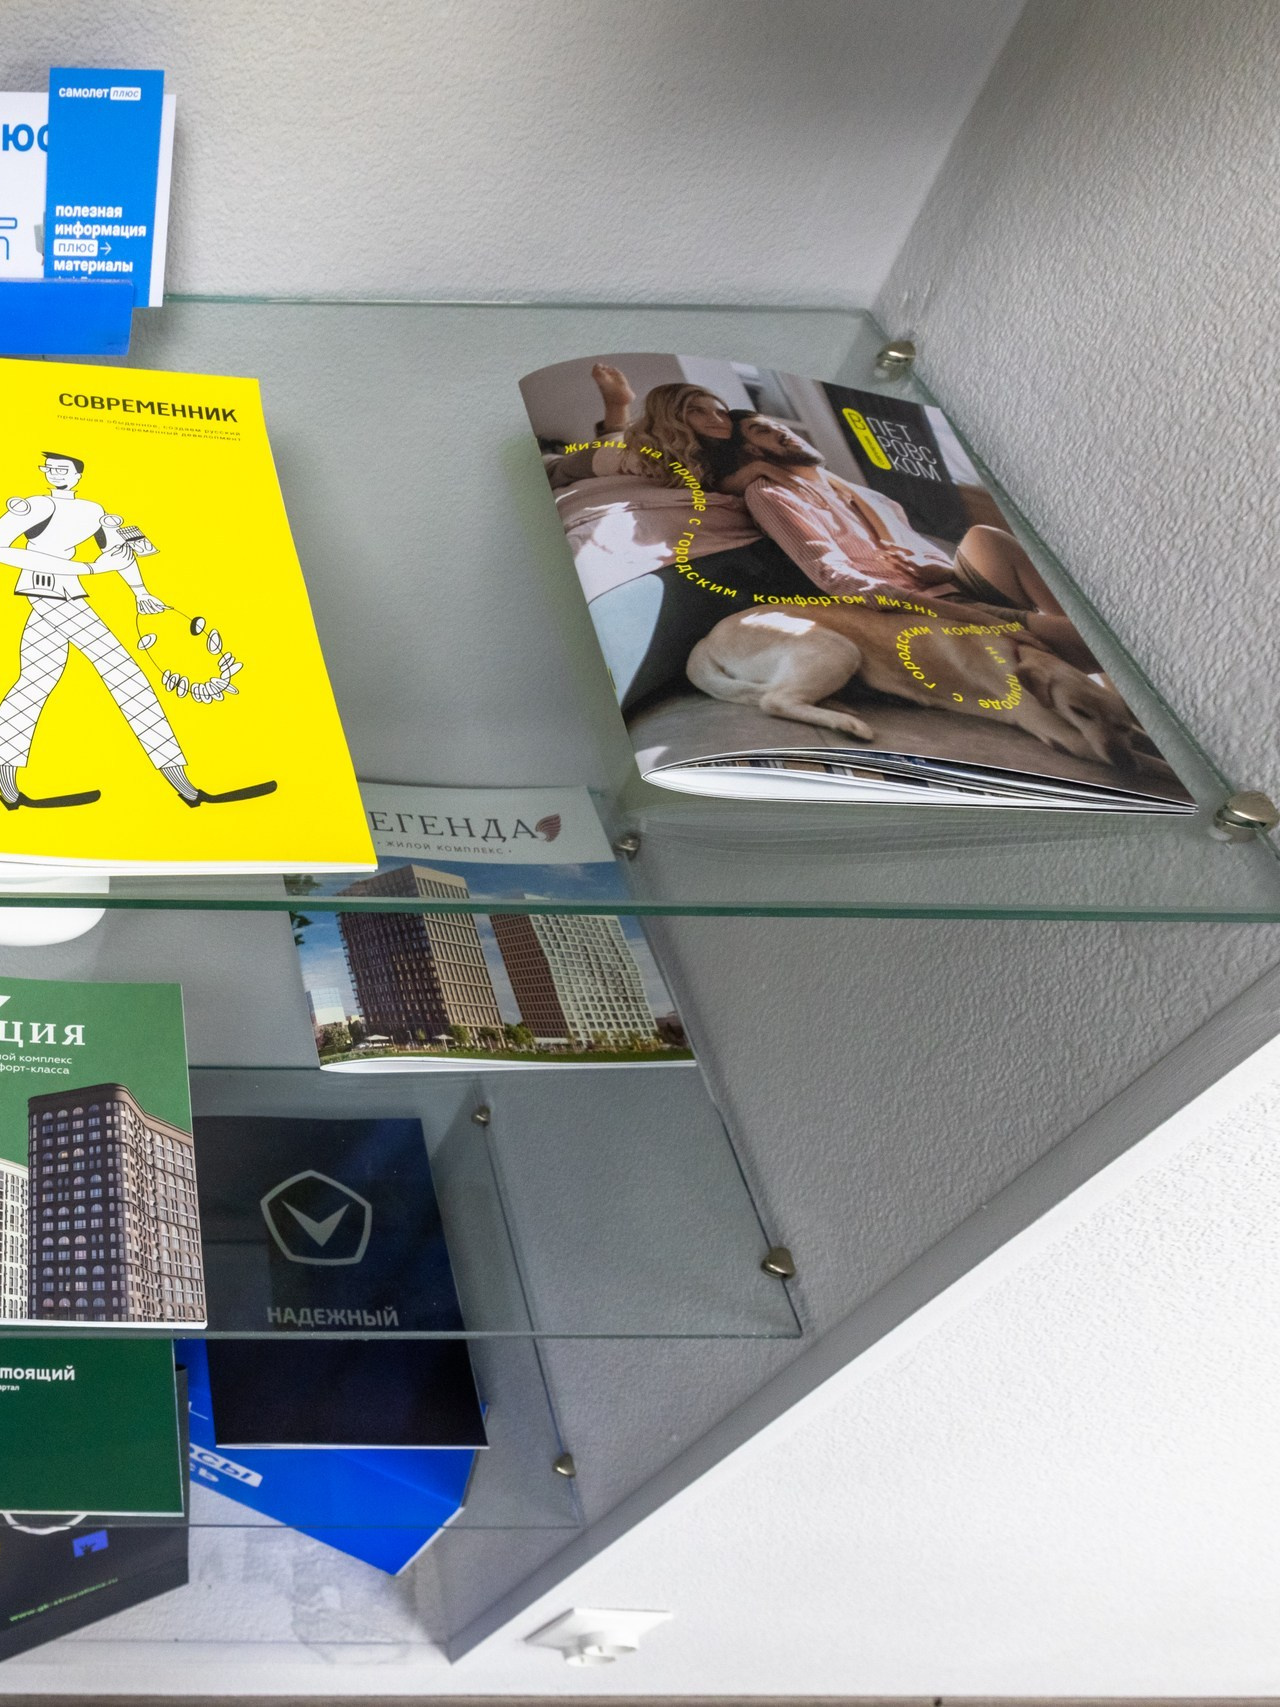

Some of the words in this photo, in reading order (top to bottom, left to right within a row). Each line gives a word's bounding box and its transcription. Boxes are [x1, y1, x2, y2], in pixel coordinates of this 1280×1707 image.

[59, 87, 109, 98] самолет
[56, 205, 123, 218] полезная
[55, 221, 147, 239] информация
[58, 243, 95, 253] плюс
[54, 260, 133, 274] материалы
[59, 393, 238, 423] СОВРЕМЕННИК
[866, 417, 911, 441] ПЕТ
[640, 446, 663, 459] на
[876, 435, 937, 465] РОВС
[887, 453, 941, 482] КОМ
[669, 461, 707, 512] природе
[688, 518, 702, 526] с
[673, 532, 738, 598] городским
[753, 593, 867, 608] комфортом
[941, 621, 1024, 637] комфортом
[896, 626, 936, 689] городским
[978, 673, 1022, 710] природе
[368, 811, 538, 843] ЕГЕНДА
[19, 1055, 73, 1065] комплекс
[266, 1306, 400, 1327] НАДЕЖНЫЙ
